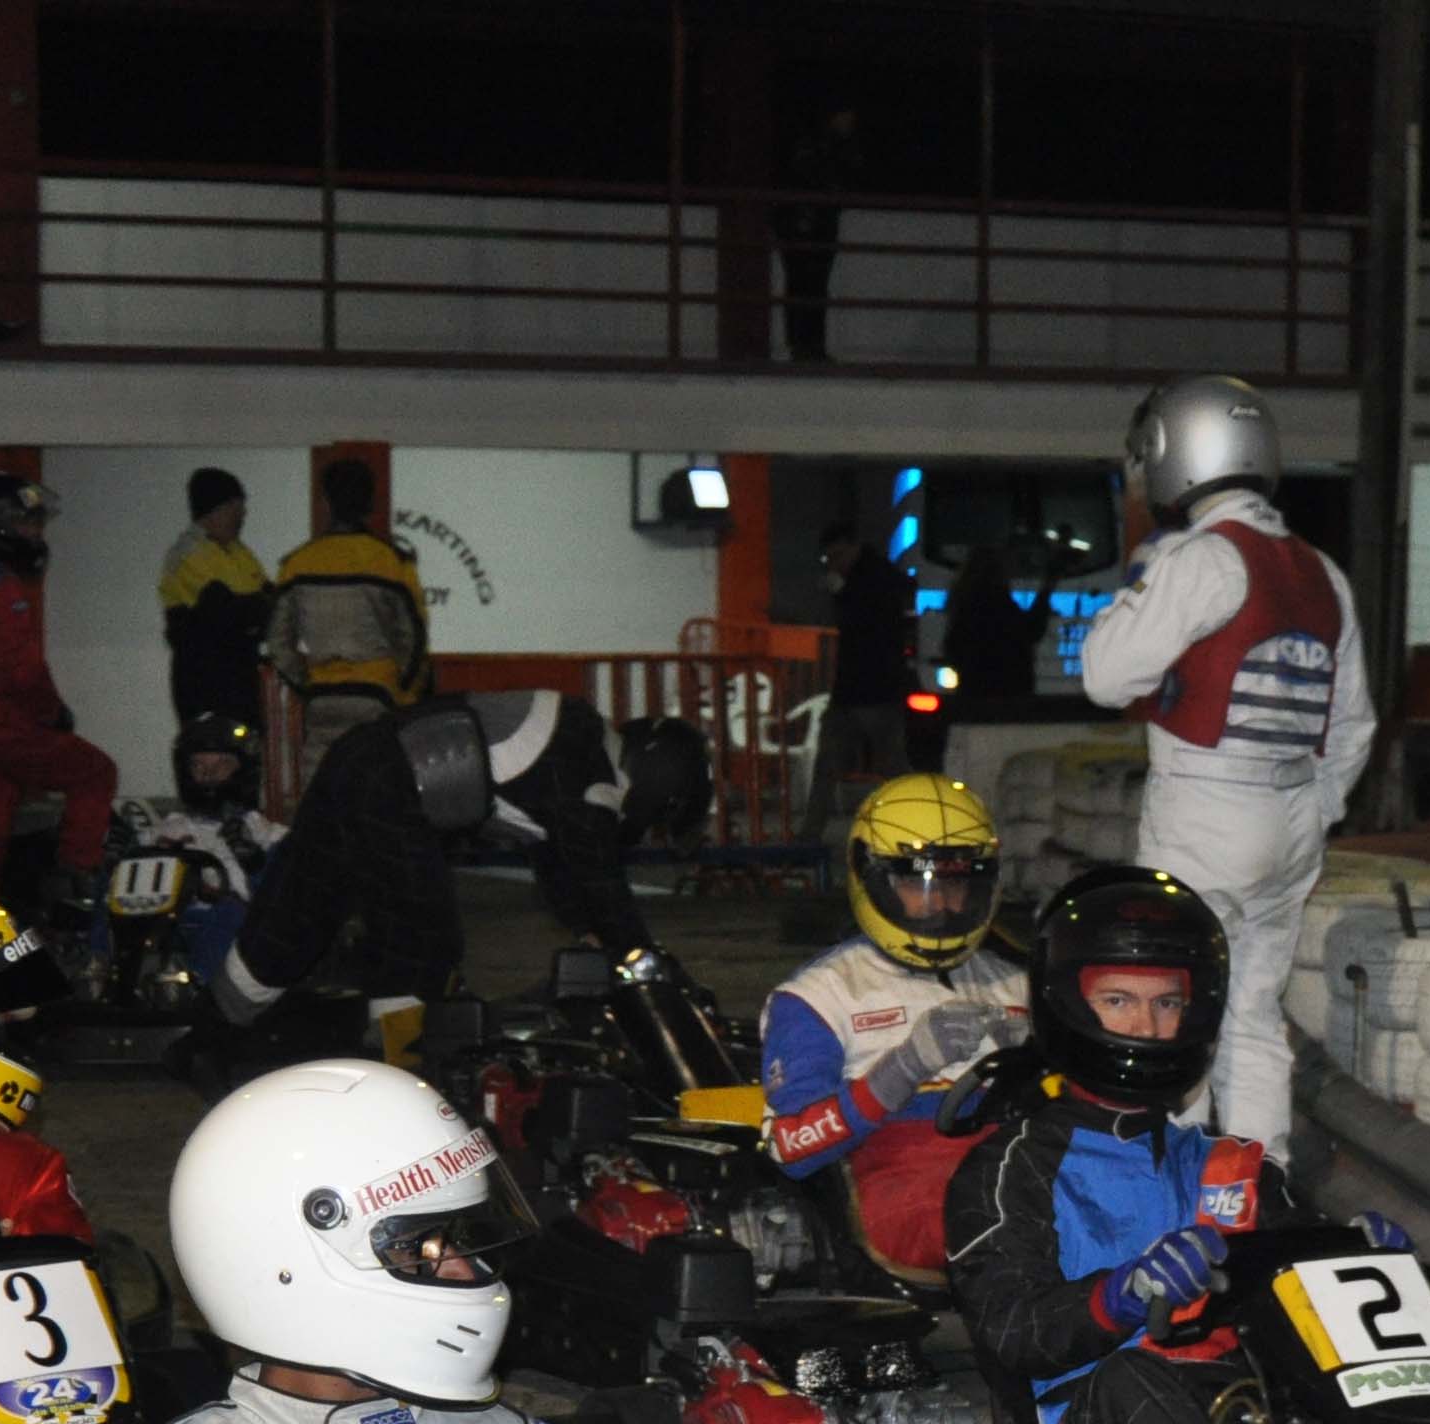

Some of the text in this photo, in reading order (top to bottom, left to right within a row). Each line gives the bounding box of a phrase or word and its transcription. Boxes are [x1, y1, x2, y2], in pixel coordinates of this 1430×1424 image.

[126, 862, 163, 894] 11
[781, 1109, 844, 1152] kart
[355, 1164, 439, 1216] Health
[4, 1272, 67, 1367] 3
[1334, 1267, 1426, 1350] 2
[27, 1378, 78, 1406] 24
